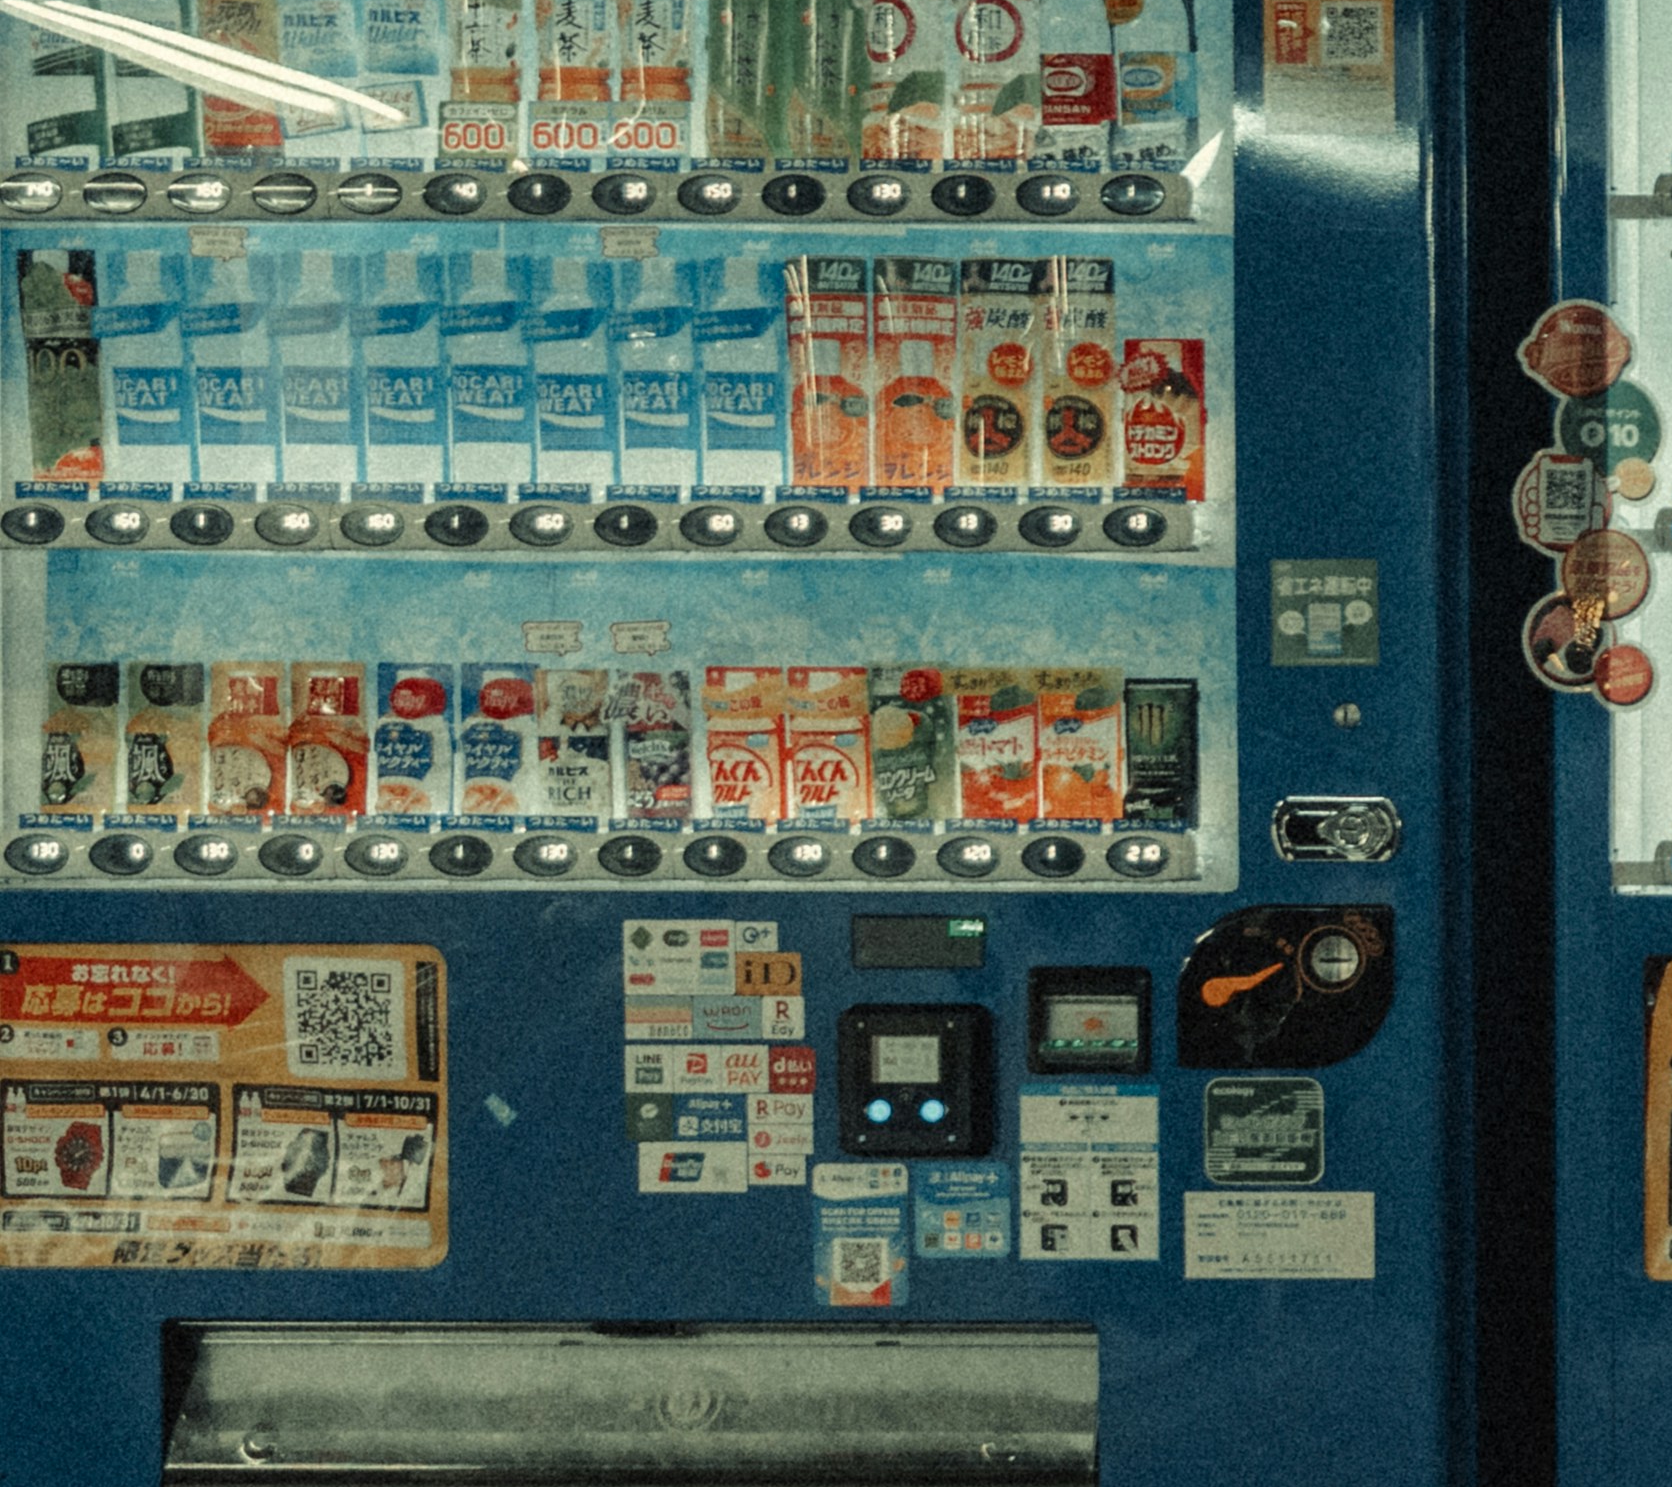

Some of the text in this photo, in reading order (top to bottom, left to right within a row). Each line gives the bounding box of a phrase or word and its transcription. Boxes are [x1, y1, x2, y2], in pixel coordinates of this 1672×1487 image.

[21, 984, 232, 1017] 応募はココから!
